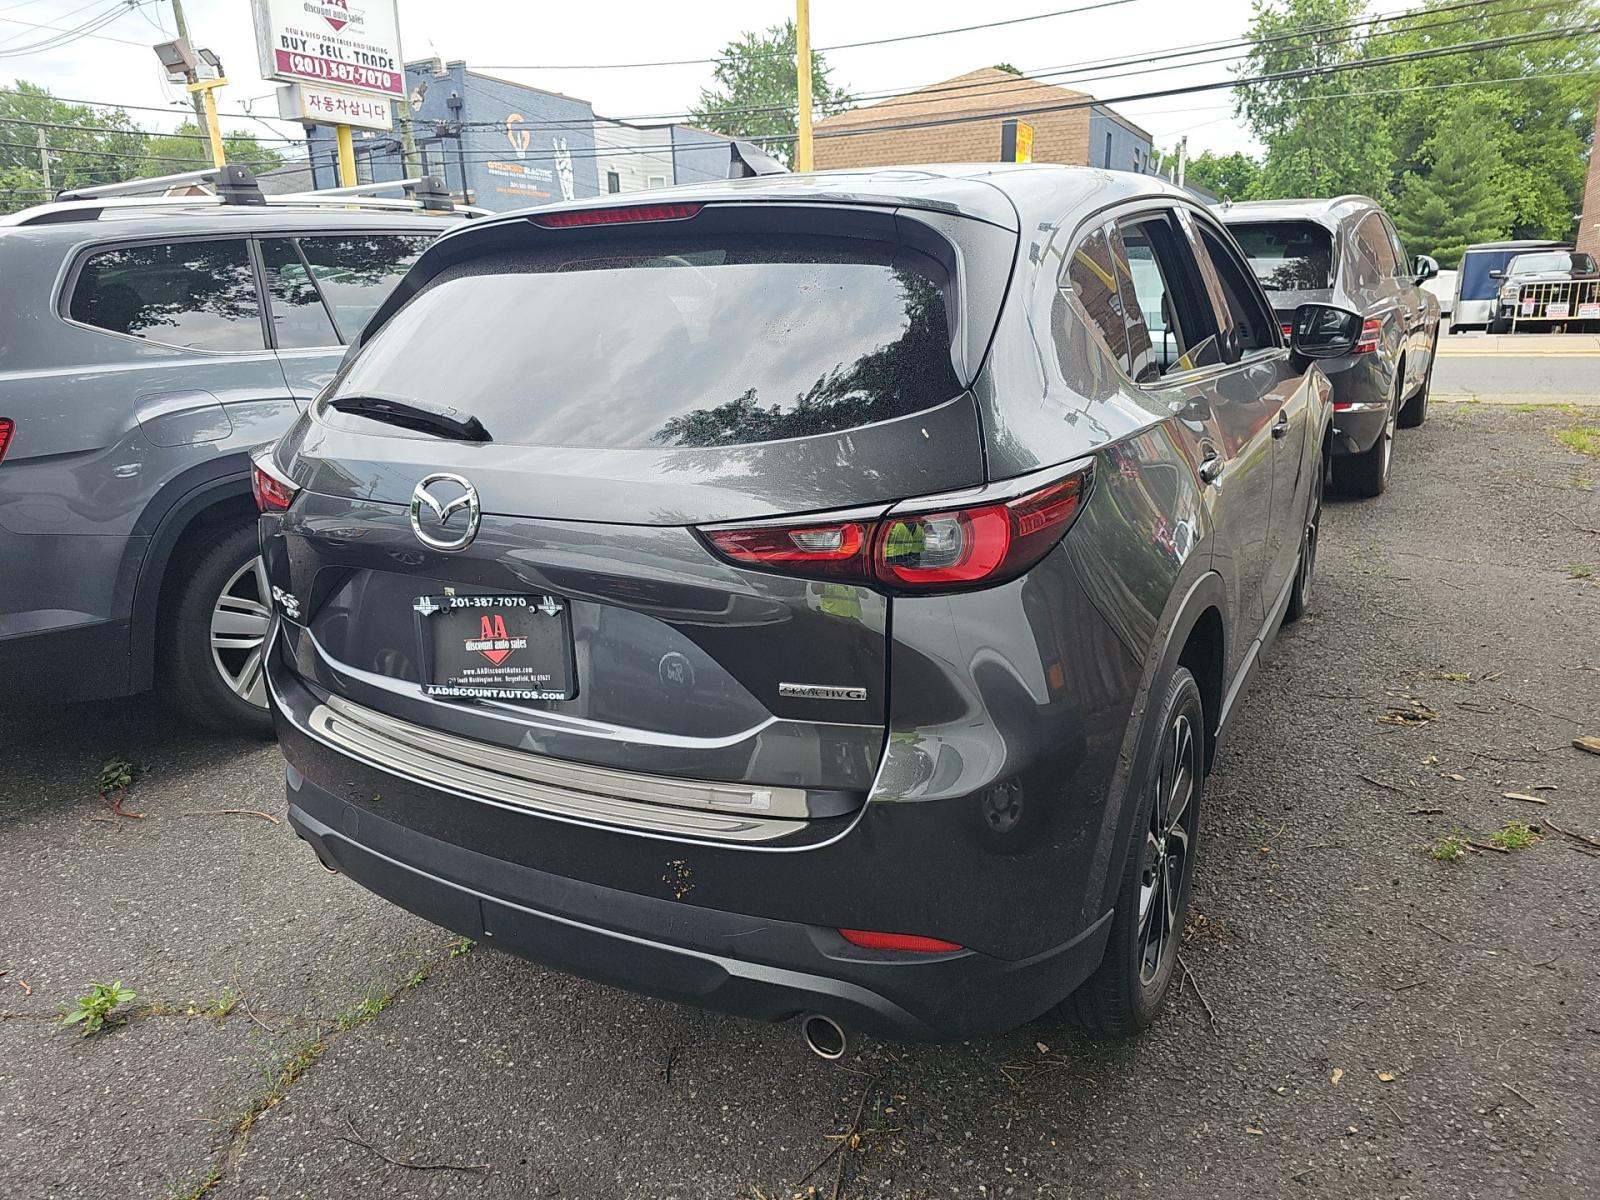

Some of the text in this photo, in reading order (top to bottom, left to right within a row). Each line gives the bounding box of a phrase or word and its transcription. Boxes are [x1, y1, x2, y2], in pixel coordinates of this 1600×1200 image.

[304, 2, 331, 16] discount
[332, 10, 348, 21] auto
[348, 13, 364, 25] sales
[305, 31, 321, 40] USED
[321, 34, 336, 44] CAR
[336, 38, 352, 47] SALES
[281, 35, 394, 70] BUY SELL TRADE
[289, 52, 392, 89] (201) 387-7070
[309, 95, 385, 120] 자동차삽니다
[450, 597, 527, 608] 201-387-7070
[481, 614, 508, 640] AA
[465, 639, 527, 651] discount auto sales
[427, 686, 565, 700] AADISCOUNTAUTOS.COM
